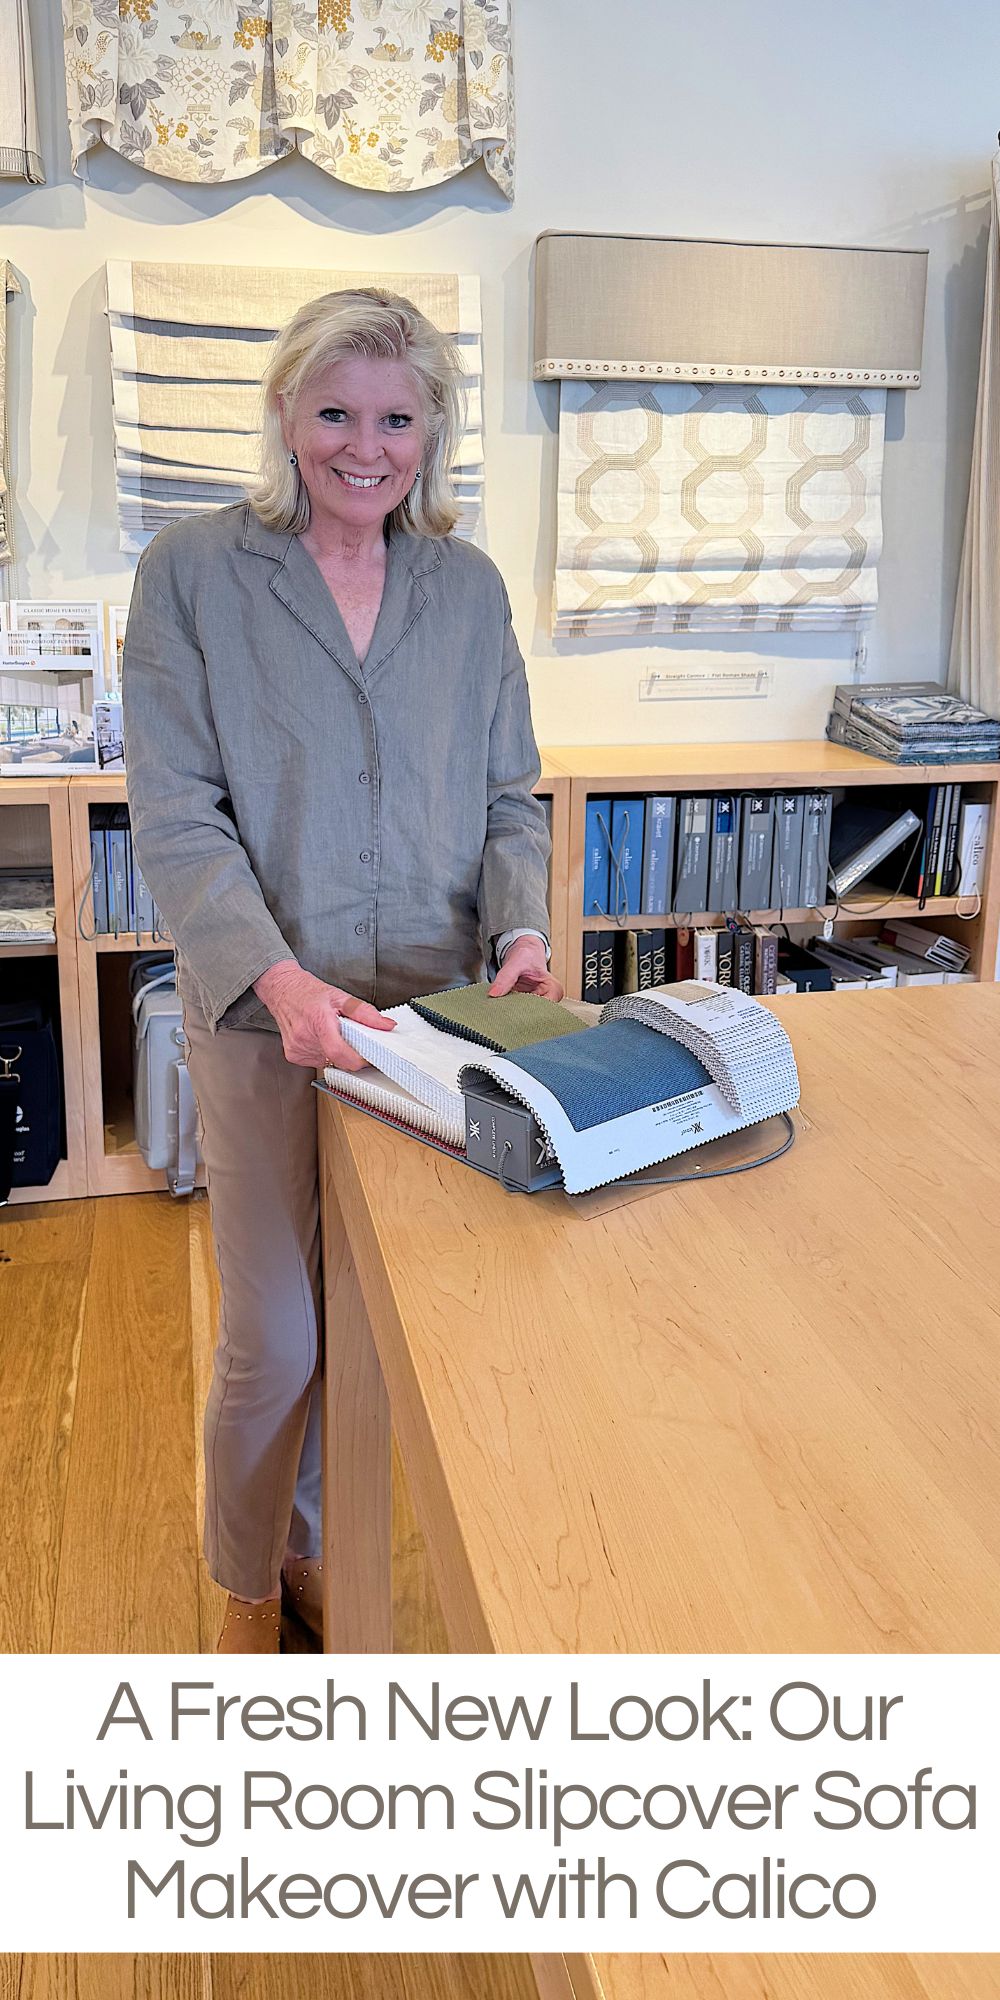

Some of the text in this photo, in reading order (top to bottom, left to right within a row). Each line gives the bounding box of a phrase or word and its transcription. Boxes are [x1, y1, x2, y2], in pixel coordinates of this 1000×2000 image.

[594, 848, 602, 870] calico
[625, 848, 633, 870] calico
[650, 849, 659, 871] calico
[972, 835, 984, 866] calico
[585, 950, 598, 990] YORK
[600, 947, 612, 986] YORK
[640, 951, 651, 991] YORK
[653, 946, 665, 985] YORK
[719, 951, 731, 987] YORK
